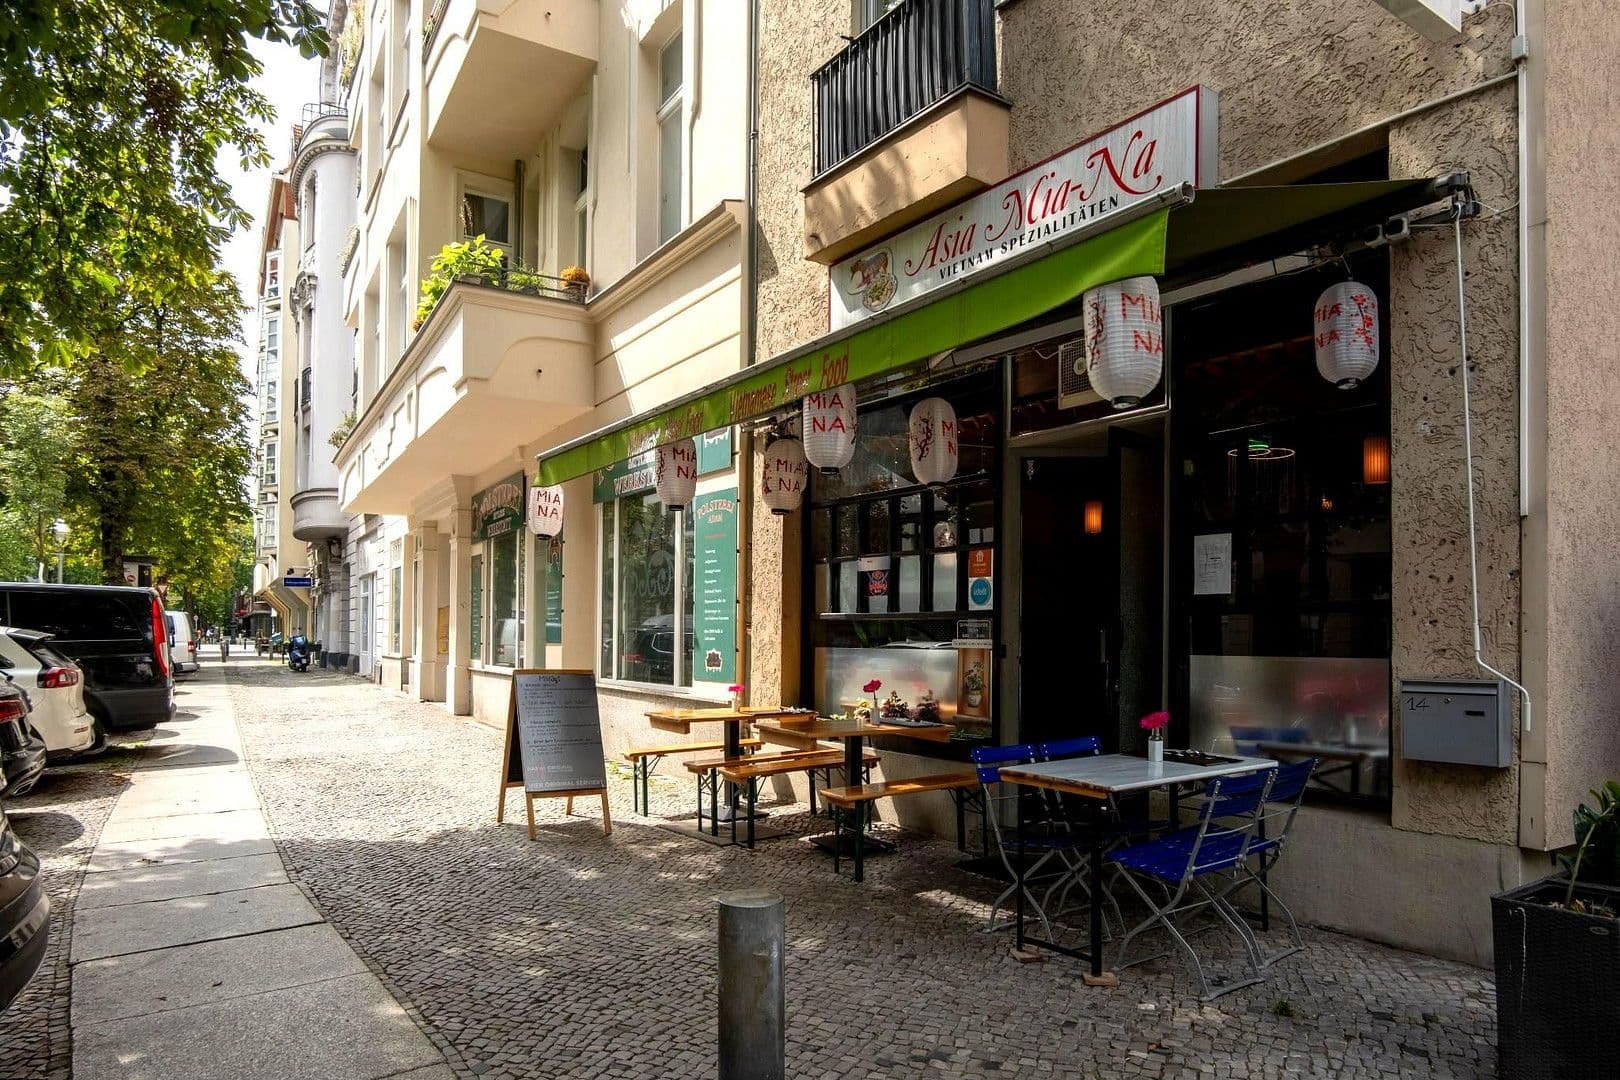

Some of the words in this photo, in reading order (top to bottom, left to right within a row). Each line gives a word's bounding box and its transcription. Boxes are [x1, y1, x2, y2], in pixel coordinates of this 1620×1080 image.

[904, 216, 977, 277] Asia
[984, 130, 1162, 241] Mia-Na
[939, 247, 993, 280] VIETNAM
[1000, 194, 1120, 255] SPEZIALITÄTEN
[812, 415, 846, 433] NA
[778, 477, 801, 494] NA
[537, 505, 559, 520] NA
[1405, 697, 1431, 711] 14
